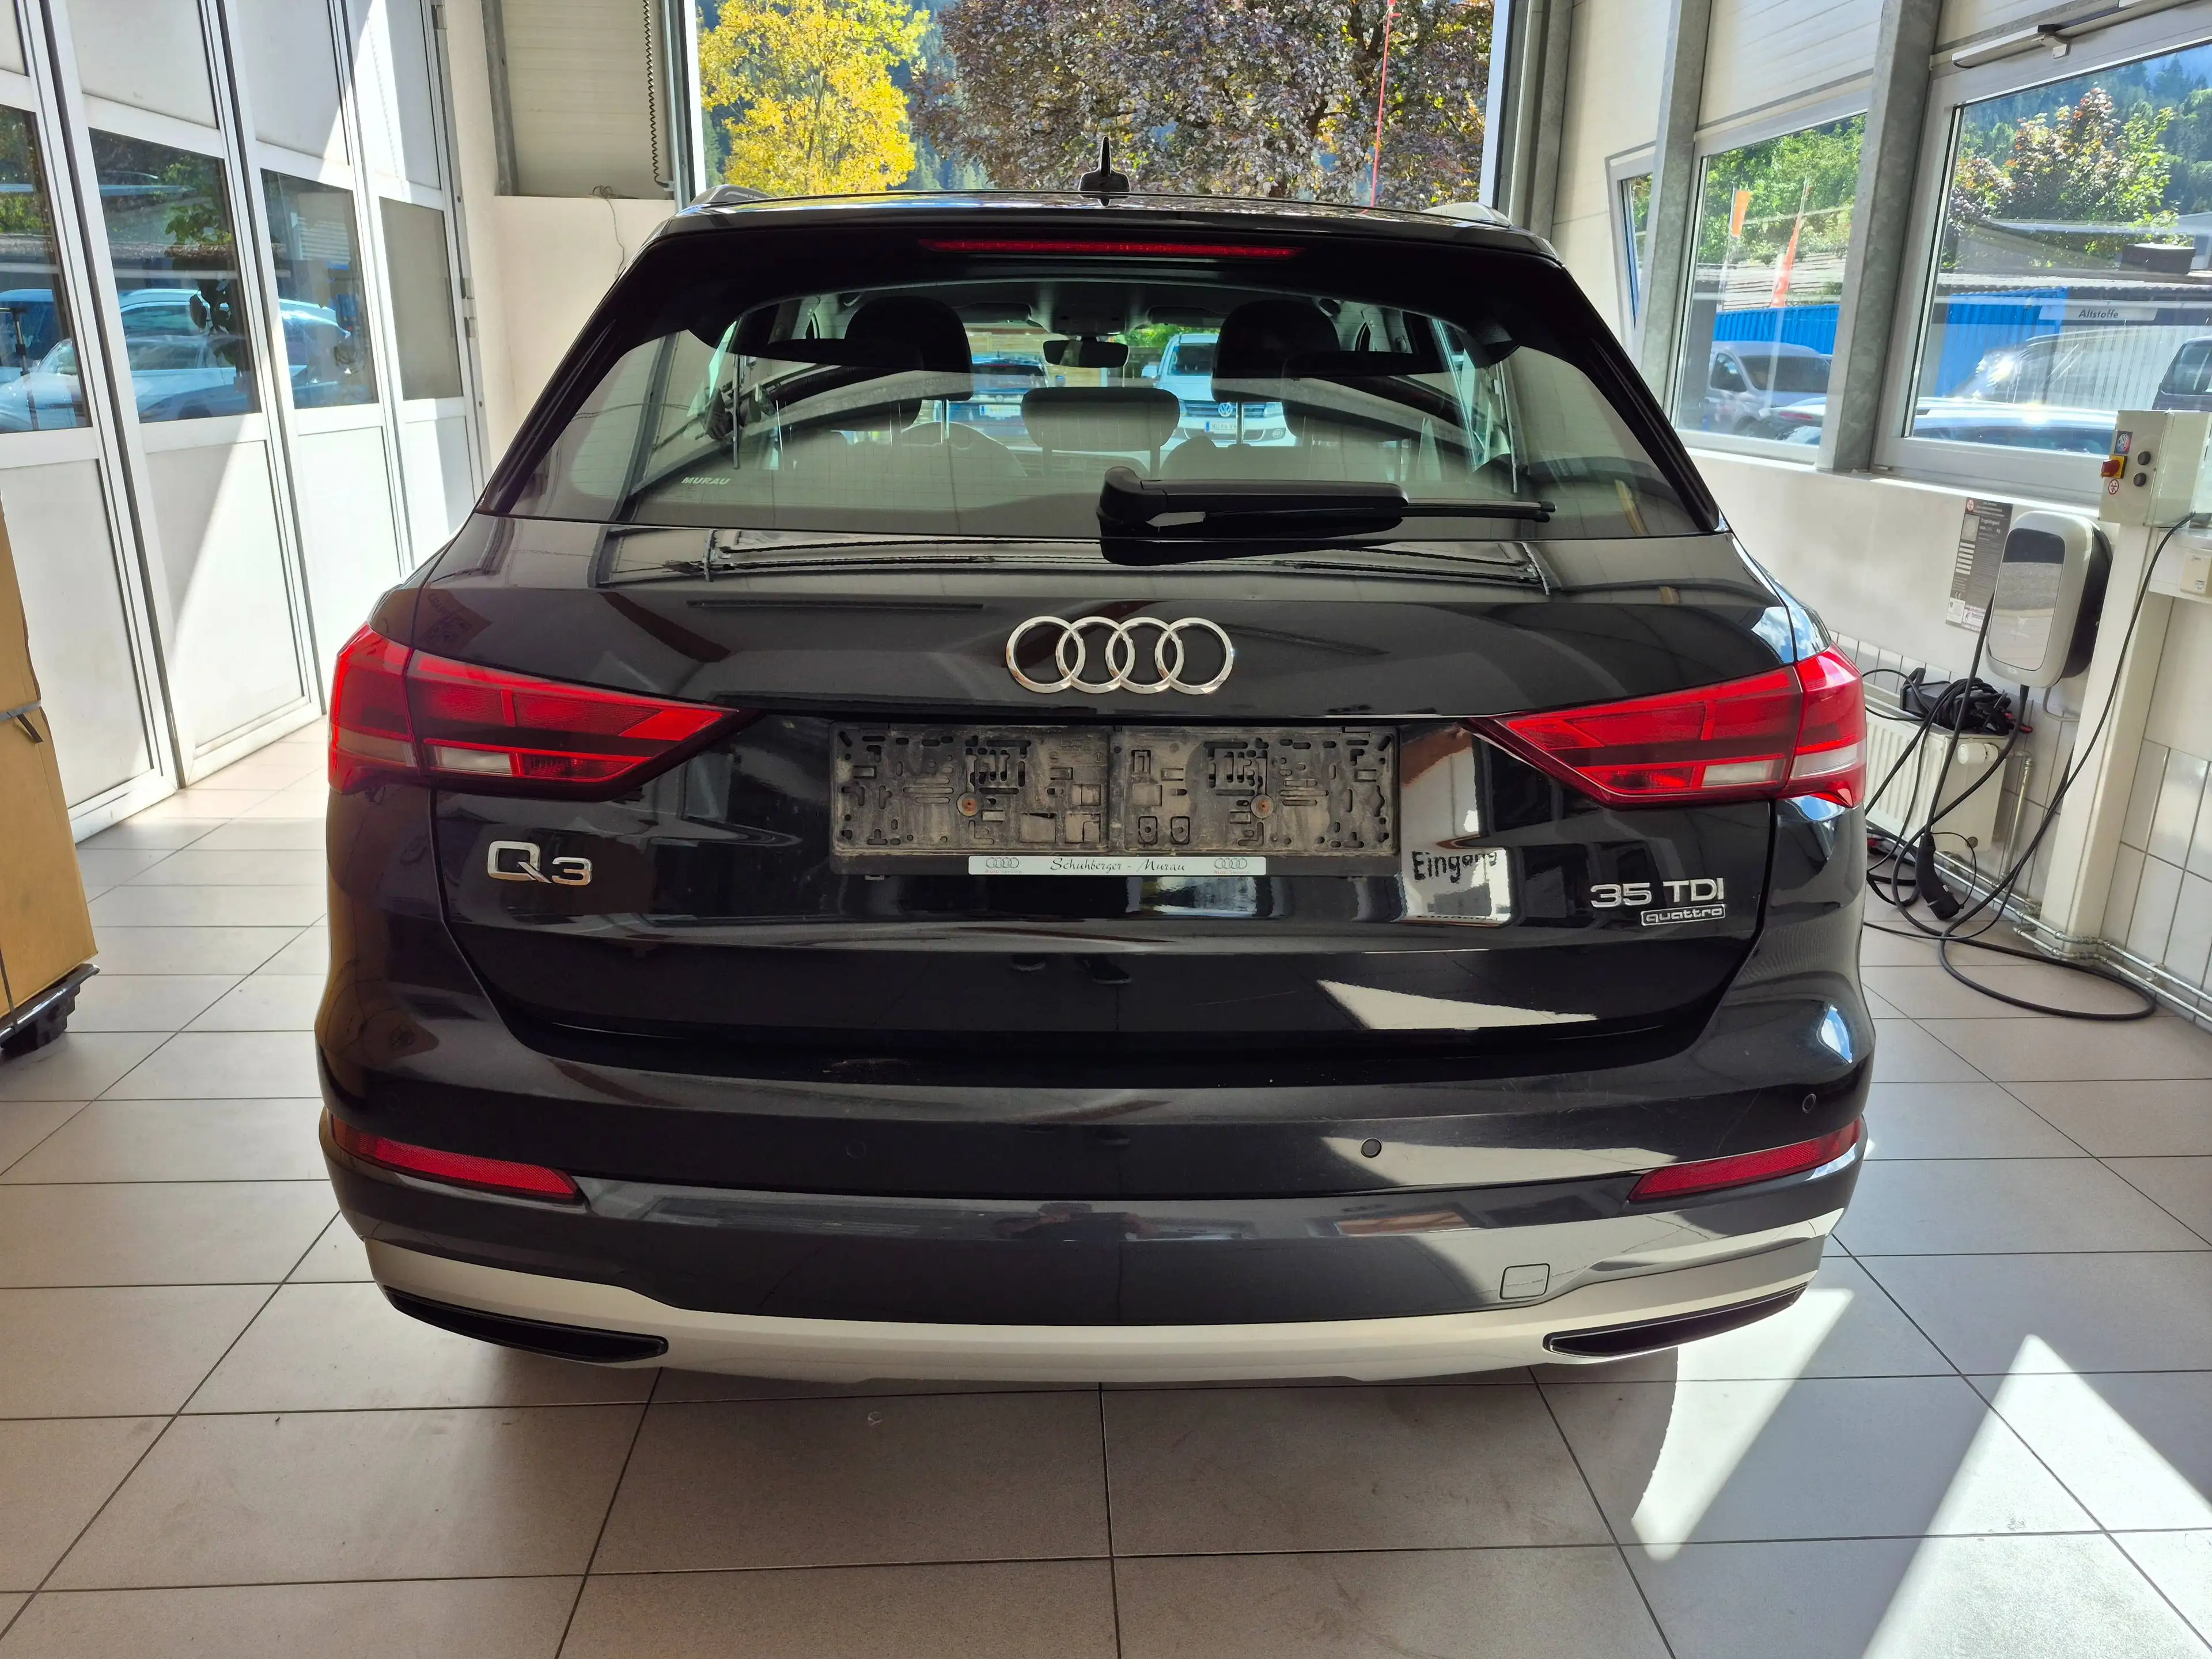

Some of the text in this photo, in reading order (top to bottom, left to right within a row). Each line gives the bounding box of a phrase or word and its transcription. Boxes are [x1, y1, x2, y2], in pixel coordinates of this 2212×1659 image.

[2078, 309, 2119, 318] Altstoffe
[681, 477, 731, 485] MURAU
[487, 840, 593, 886] Q3
[1050, 857, 1122, 873] Schuhberger
[1137, 858, 1185, 872] Murau
[1590, 877, 1725, 908] 35 TDI
[1645, 907, 1723, 923] quattro
